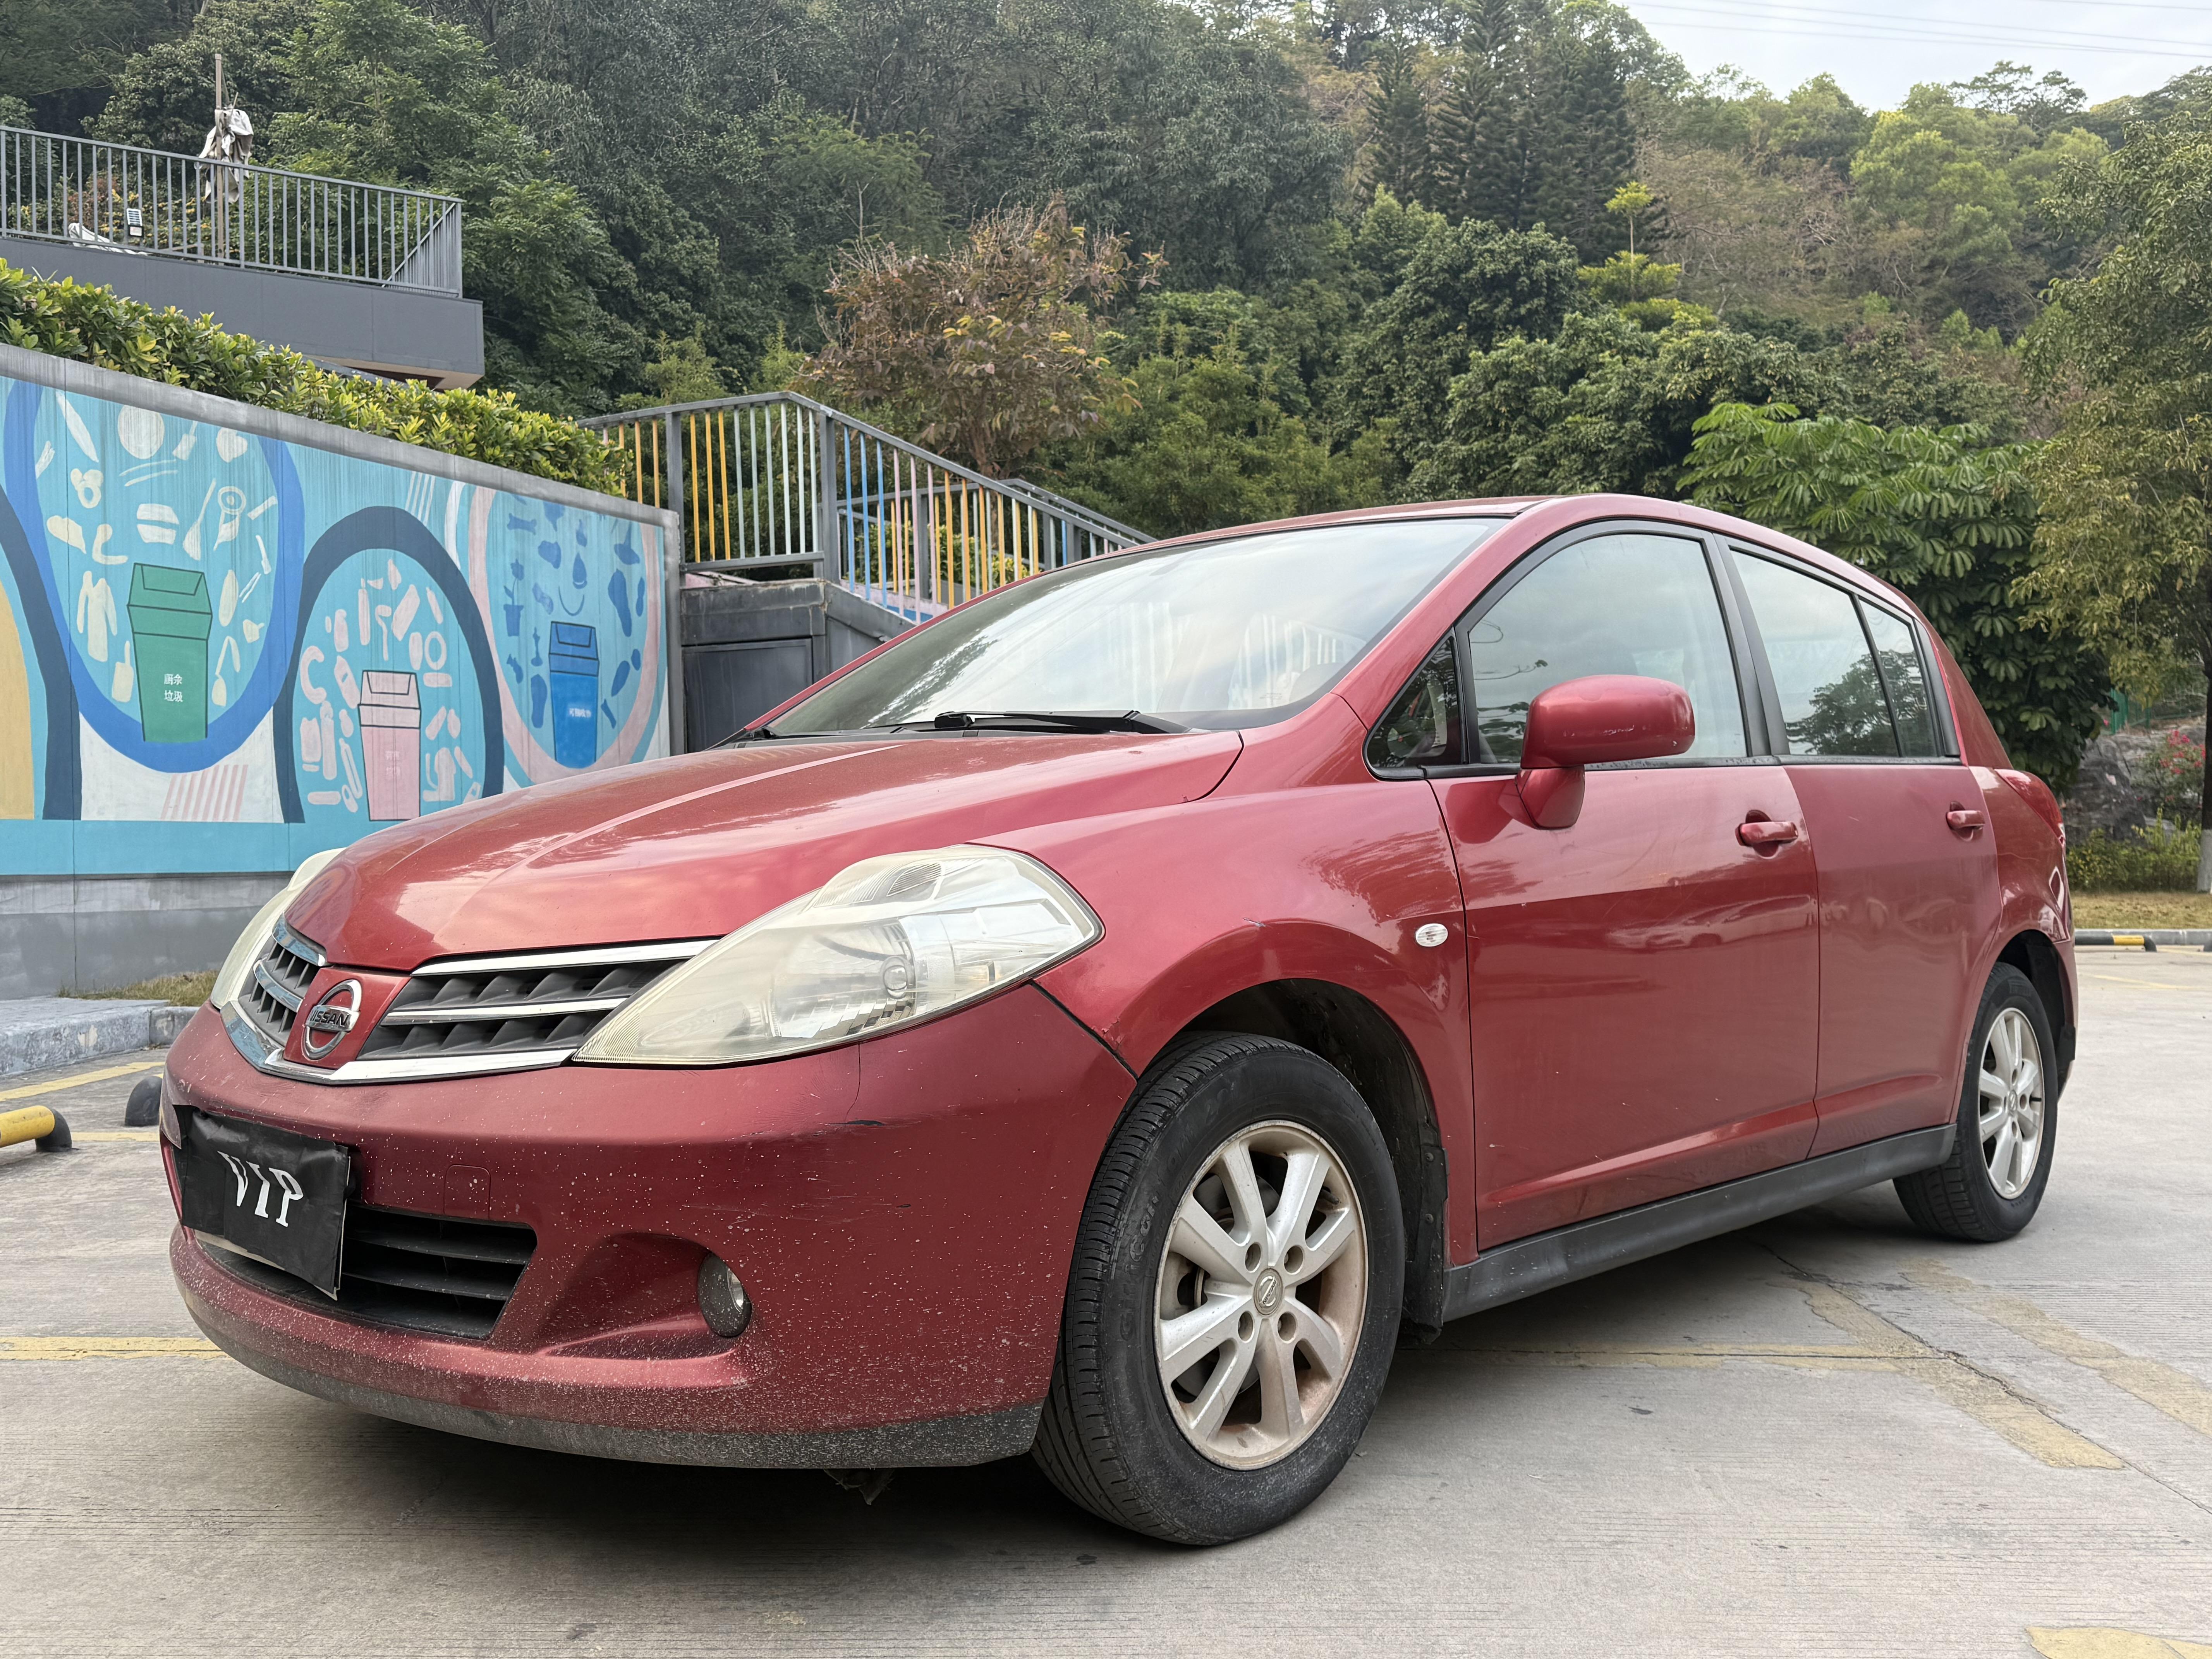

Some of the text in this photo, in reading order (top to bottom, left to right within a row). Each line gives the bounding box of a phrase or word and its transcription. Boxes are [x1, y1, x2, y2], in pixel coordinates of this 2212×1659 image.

[164, 673, 182, 685] 厨余
[164, 690, 183, 702] 垃圾
[310, 1009, 349, 1027] NISSAN
[217, 1151, 304, 1227] VIP
